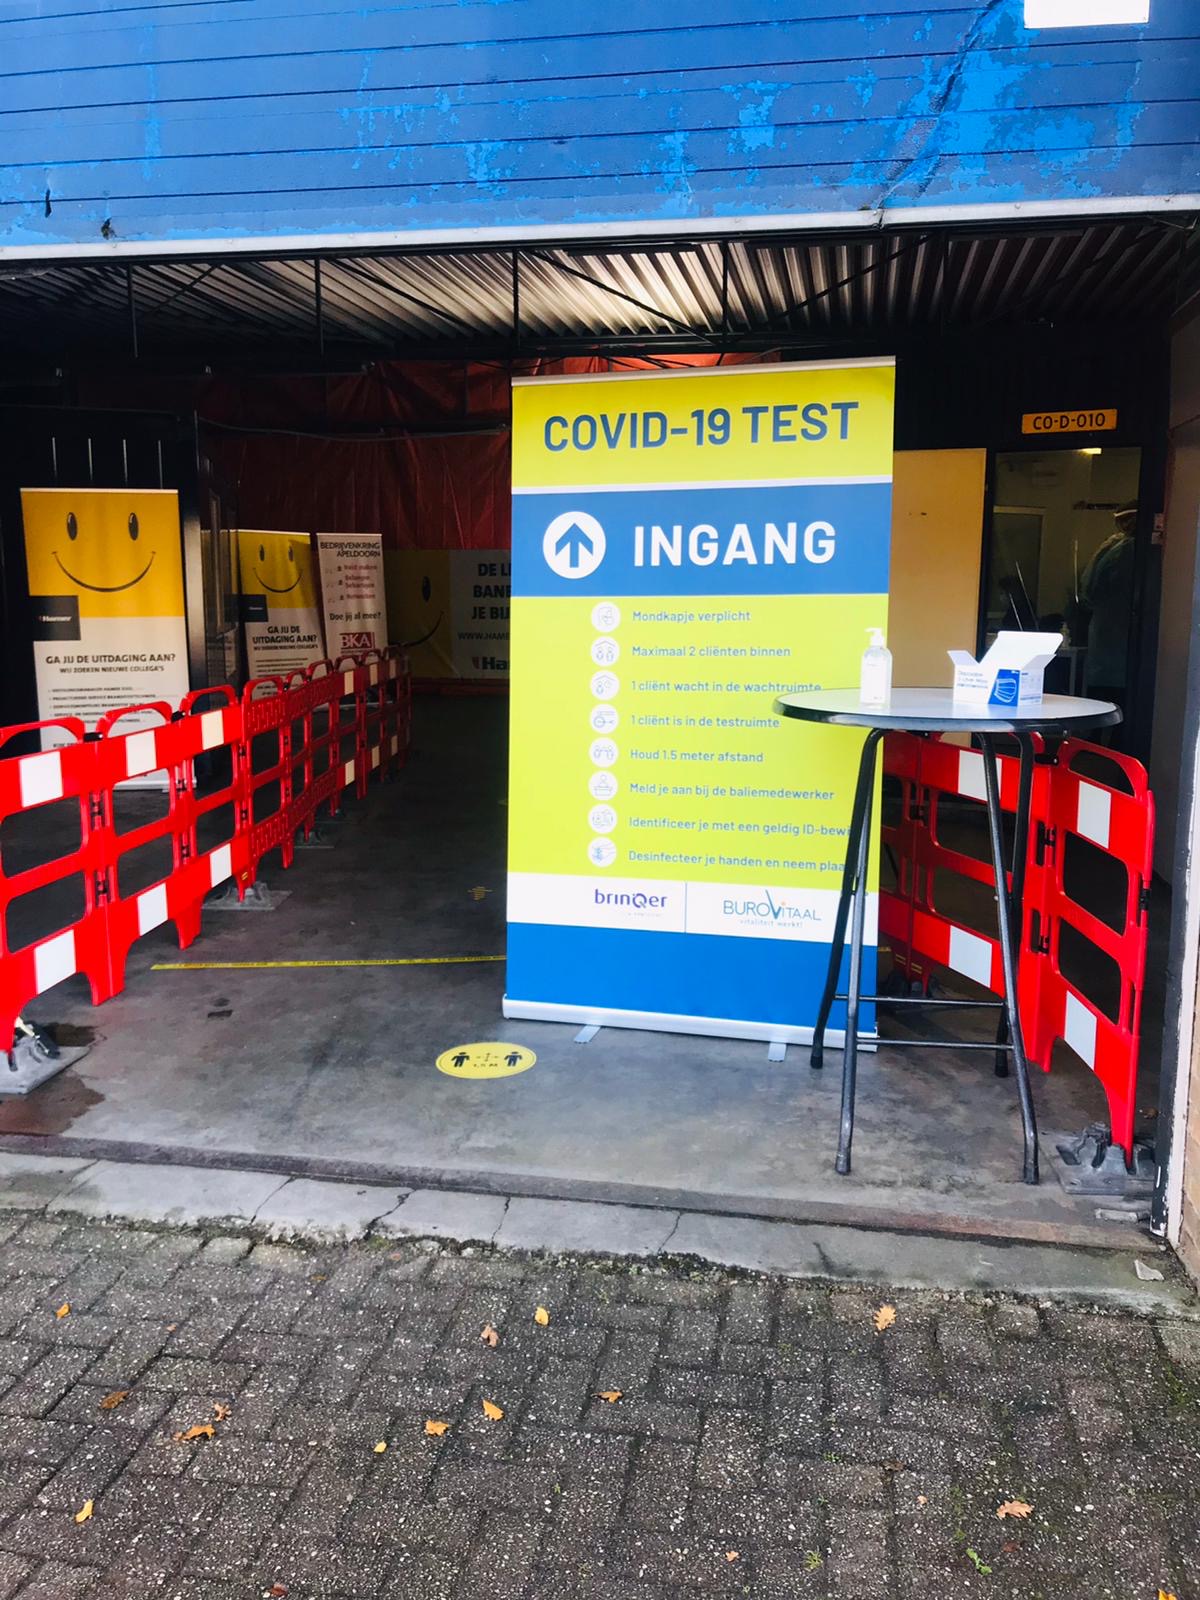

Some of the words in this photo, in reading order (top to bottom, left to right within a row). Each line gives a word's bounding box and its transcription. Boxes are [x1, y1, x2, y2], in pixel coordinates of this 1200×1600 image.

[544, 408, 731, 452] COVID-19
[742, 402, 859, 443] TEST
[634, 521, 836, 568] INGANG
[478, 563, 497, 577] DE
[329, 612, 344, 621] Doe
[472, 607, 486, 620] JE
[633, 611, 695, 623] Mondkapje
[698, 611, 751, 623] verplicht
[267, 626, 279, 634] GA
[290, 625, 301, 633] DE
[252, 635, 295, 645] UITDAGING
[296, 634, 317, 643] AAN?
[341, 633, 372, 648] BKA
[632, 646, 686, 657] Maximaal
[689, 646, 696, 657] 2
[699, 645, 747, 657] cliënten
[750, 645, 791, 657] binnen
[45, 655, 61, 664] GA
[76, 655, 89, 664] DE
[91, 654, 147, 664] UITDAGING
[149, 653, 176, 663] AAN?
[73, 666, 100, 674] ZOEKEN
[632, 681, 637, 692] 1
[639, 681, 671, 692] cliënt
[673, 681, 710, 693] wacht
[712, 682, 722, 693] in
[725, 682, 740, 693] de
[743, 682, 822, 693] wachtruimte
[631, 716, 637, 727] 1
[638, 716, 670, 727] cliënt
[673, 716, 683, 727] is
[685, 716, 696, 728] in
[699, 716, 713, 728] de
[716, 717, 780, 729] testruimte
[630, 750, 660, 761] Houd
[662, 751, 678, 762] 1.5
[680, 752, 715, 763] meter
[718, 751, 764, 764] afstand
[629, 783, 657, 794] Meld
[658, 784, 669, 797] je
[671, 787, 692, 796] aan
[695, 785, 710, 798] bij
[712, 786, 727, 797] de
[729, 786, 834, 801] baliemedewerker
[629, 817, 696, 830] Identificeer
[698, 819, 709, 832] je
[712, 821, 735, 832] met
[738, 823, 760, 833] een
[763, 822, 800, 837] geldig
[628, 850, 702, 865] Desinfecteer
[704, 852, 716, 867] je
[718, 854, 762, 867] handen
[765, 859, 780, 869] en
[783, 859, 817, 871] neem
